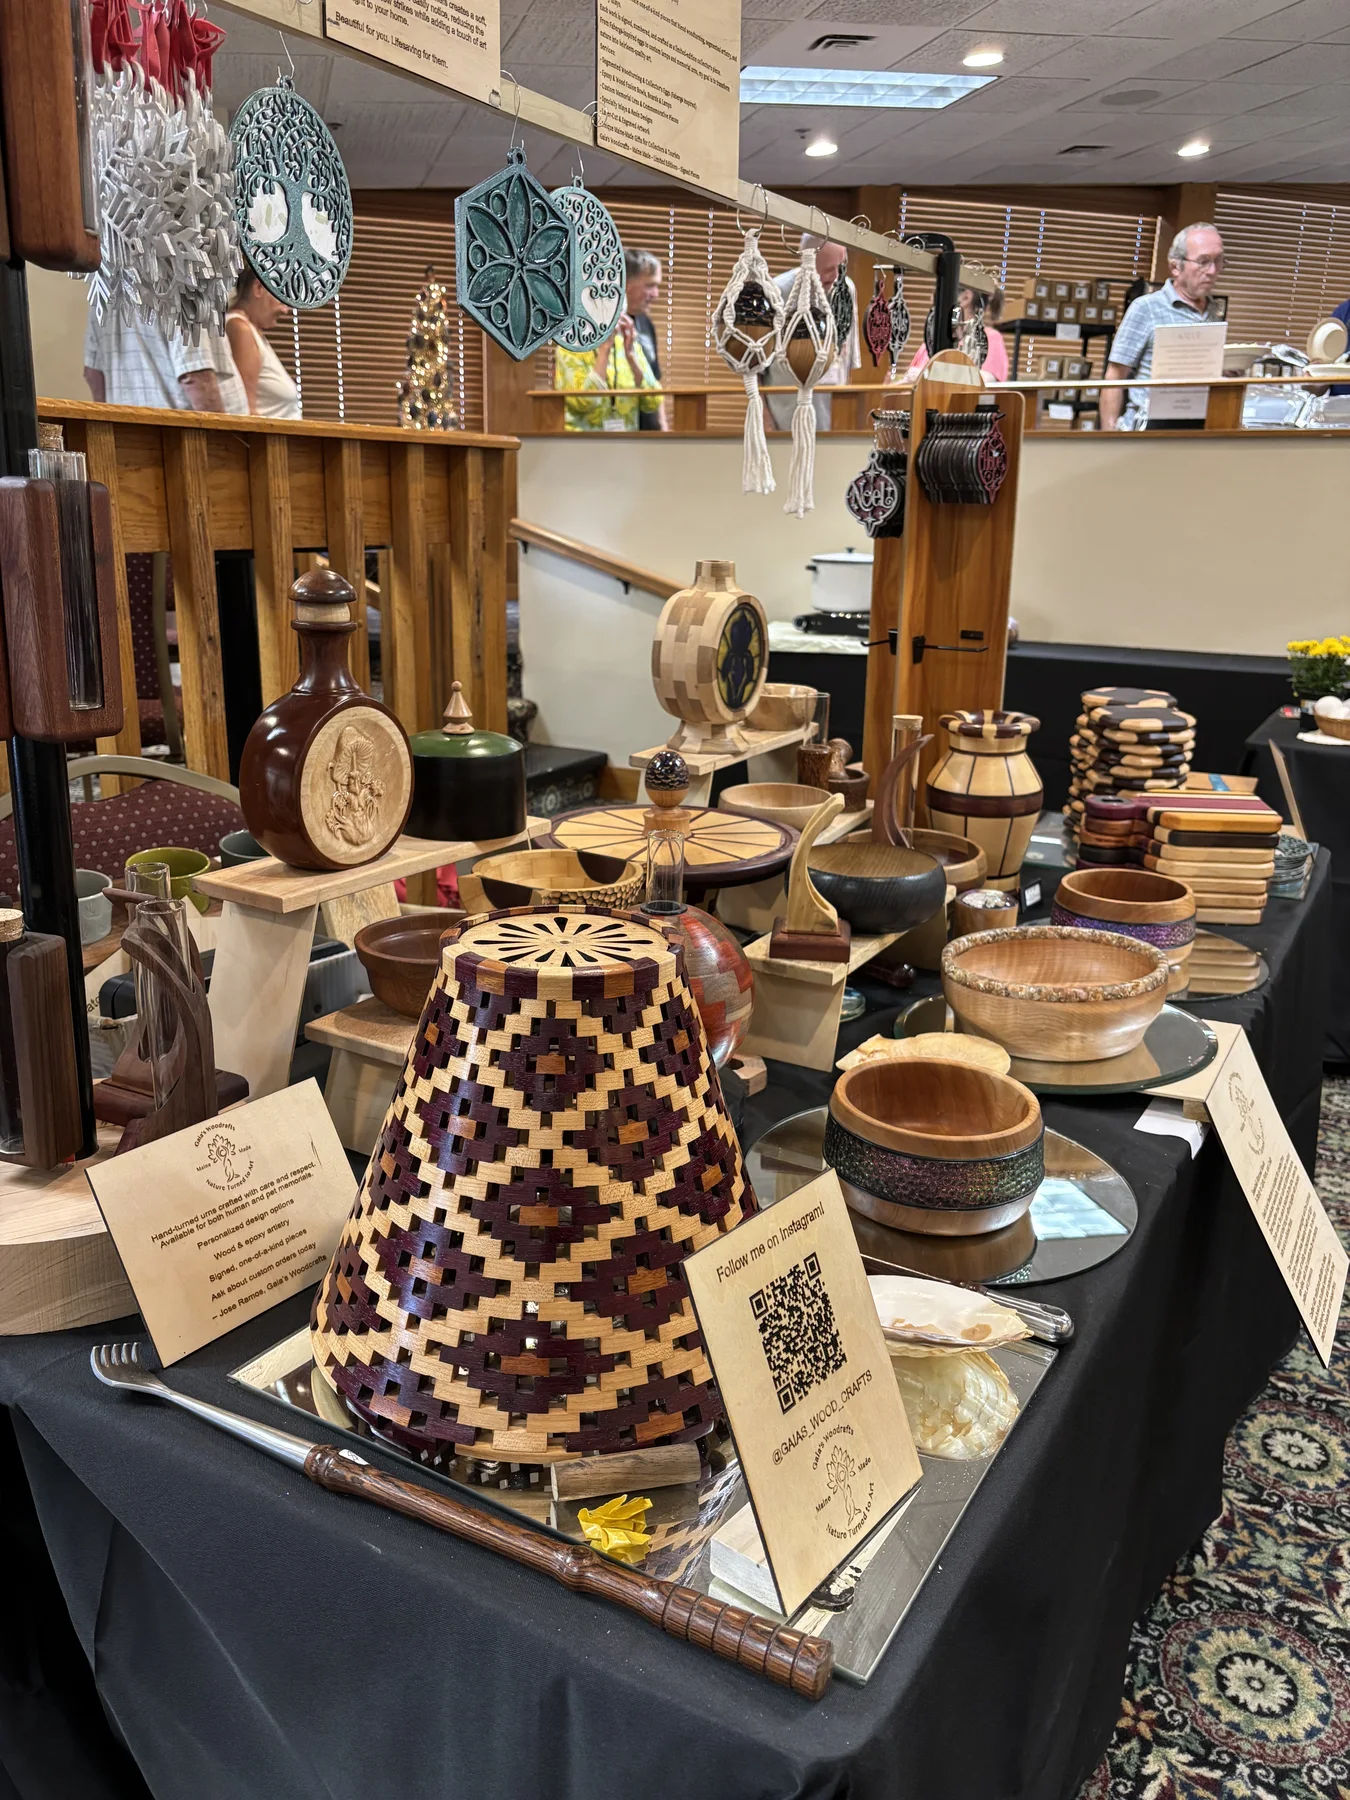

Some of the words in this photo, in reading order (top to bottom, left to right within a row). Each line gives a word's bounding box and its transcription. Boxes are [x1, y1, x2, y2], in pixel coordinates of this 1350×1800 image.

[375, 4, 389, 16] your
[390, 9, 409, 26] home.
[393, 1, 413, 15] strikes
[414, 10, 430, 23] while
[431, 18, 450, 34] adding
[456, 28, 472, 43] touch
[473, 37, 479, 45] of
[479, 41, 487, 50] art
[431, 5, 449, 21] notice,
[451, 15, 474, 34] reducing
[475, 25, 484, 36] the
[449, 2, 469, 17] creates
[470, 12, 474, 20] a
[475, 15, 487, 27] soft,
[336, 11, 364, 32] Beautiful
[366, 24, 375, 36] for
[376, 31, 390, 43] you.
[391, 36, 421, 59] Lifesaving
[423, 50, 431, 60] for
[432, 54, 448, 68] them.
[151, 1215, 199, 1242] Hand-turned
[200, 1208, 217, 1219] urns
[218, 1195, 243, 1211] crafted
[244, 1189, 258, 1199] with
[260, 1181, 275, 1191] care
[276, 1173, 289, 1183] and
[290, 1162, 316, 1177] respect.
[206, 1179, 225, 1191] Nature
[227, 1177, 246, 1190] Turned
[161, 1228, 195, 1249] Available
[196, 1222, 206, 1231] for
[207, 1214, 224, 1225] both
[225, 1202, 250, 1217] human
[251, 1194, 265, 1204] and
[266, 1188, 277, 1199] pet
[278, 1173, 313, 1191] memorials.
[197, 1222, 244, 1249] Personalized
[245, 1211, 269, 1226] design
[270, 1199, 294, 1214] options
[209, 1265, 237, 1282] Signed,
[239, 1239, 284, 1267] one-of-a-kind
[285, 1229, 307, 1244] pieces
[213, 1245, 236, 1260] Wood
[245, 1231, 265, 1245] epoxy
[267, 1220, 289, 1234] artistry
[716, 1253, 748, 1283] Follow
[750, 1244, 765, 1261] me
[767, 1235, 779, 1249] on
[212, 1290, 226, 1302] Ask
[227, 1278, 248, 1293] about
[249, 1264, 274, 1281] custom
[275, 1253, 297, 1267] orders
[297, 1242, 316, 1255] today
[220, 1304, 237, 1317] Jose
[238, 1289, 266, 1306] Ramos,
[267, 1275, 289, 1290] Gaia's
[289, 1255, 327, 1278] Woodcrafts
[774, 1369, 872, 1465] @GAIAS_WOOD_CRAFTS
[813, 1442, 824, 1470] Gaia's
[816, 1496, 831, 1512] Maine
[858, 1457, 871, 1471] Made
[826, 1524, 847, 1539] Nature
[848, 1511, 867, 1537] Turned
[865, 1501, 871, 1512] to
